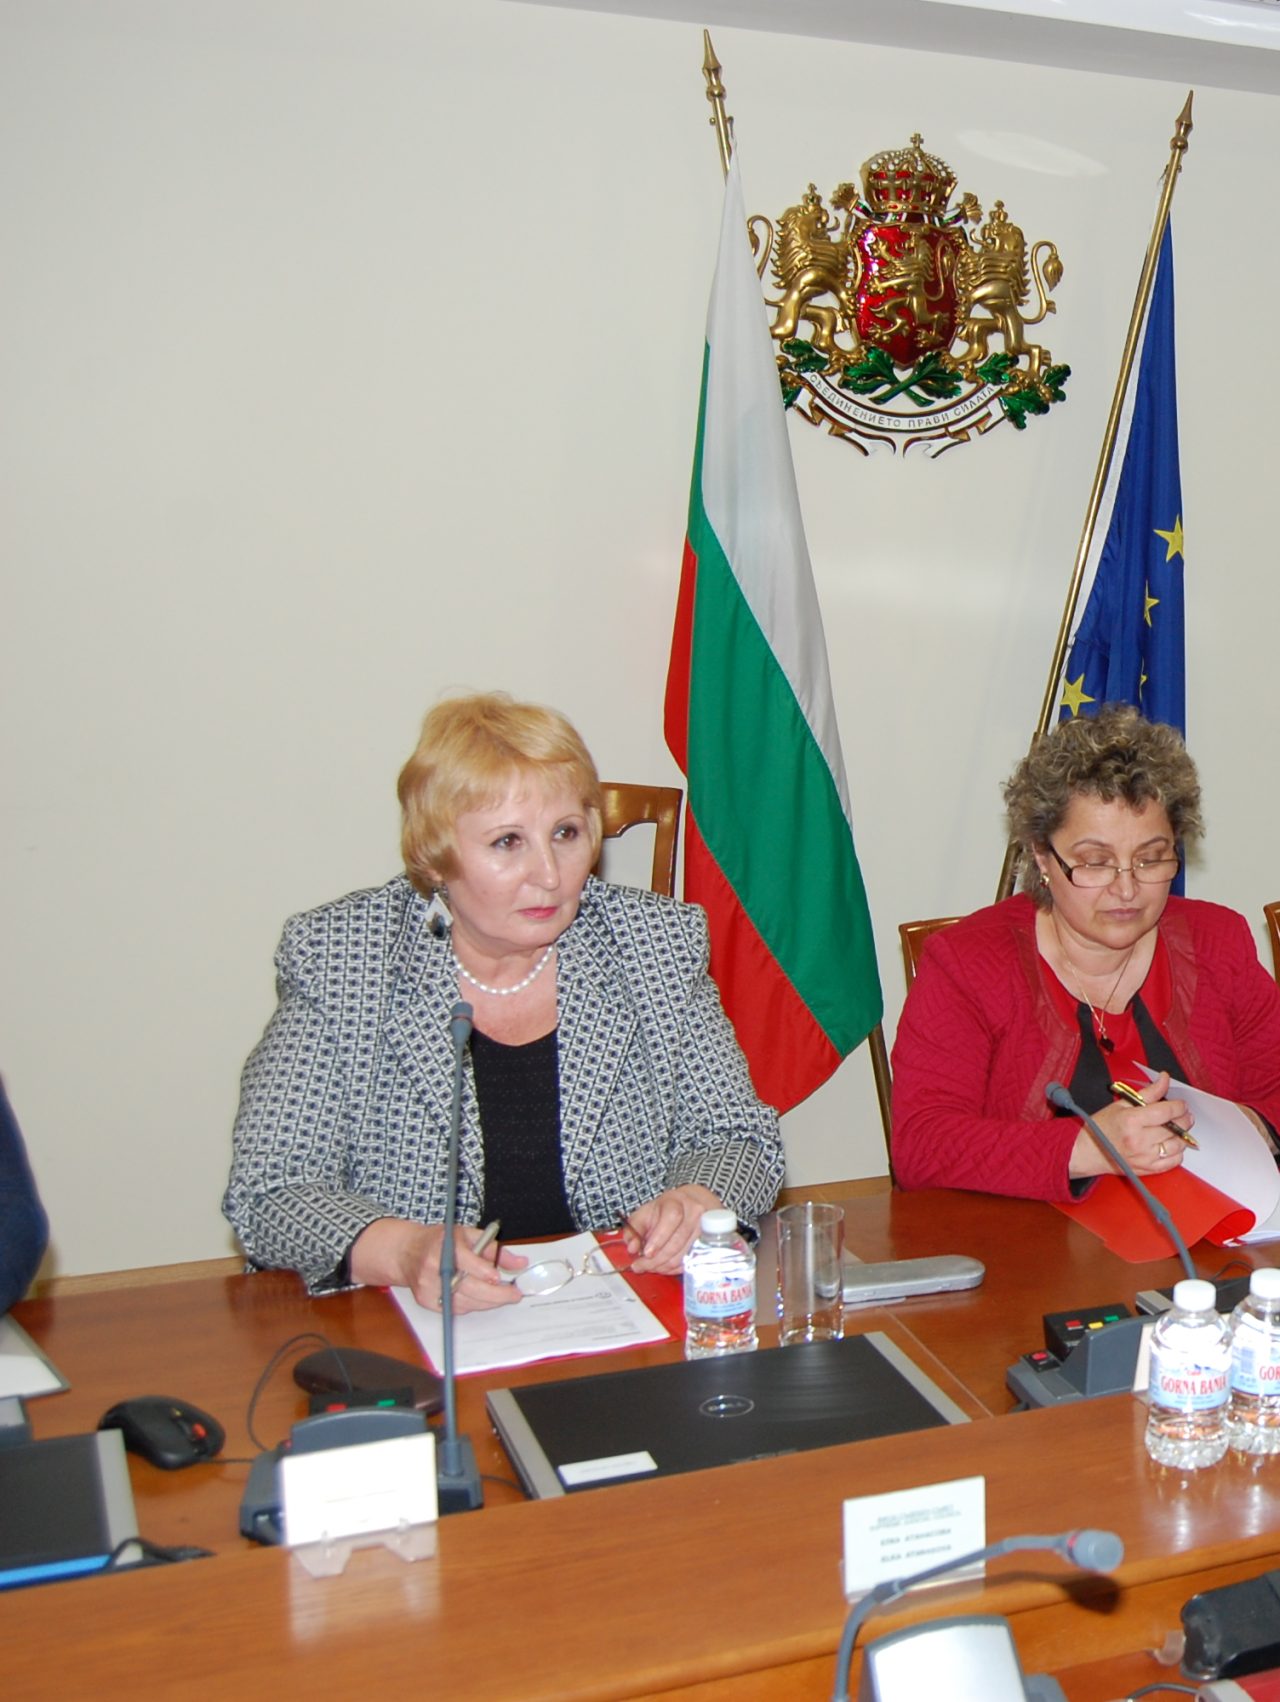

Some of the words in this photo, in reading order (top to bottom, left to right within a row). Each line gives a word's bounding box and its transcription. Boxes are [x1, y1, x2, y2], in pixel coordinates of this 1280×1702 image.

[809, 373, 902, 428] СЪЕДИНЕНИЕТО
[908, 412, 951, 428] ПРАВИ
[953, 385, 995, 416] СИЛАТА
[696, 1290, 729, 1305] GORNA
[1161, 1376, 1197, 1396] GORNA
